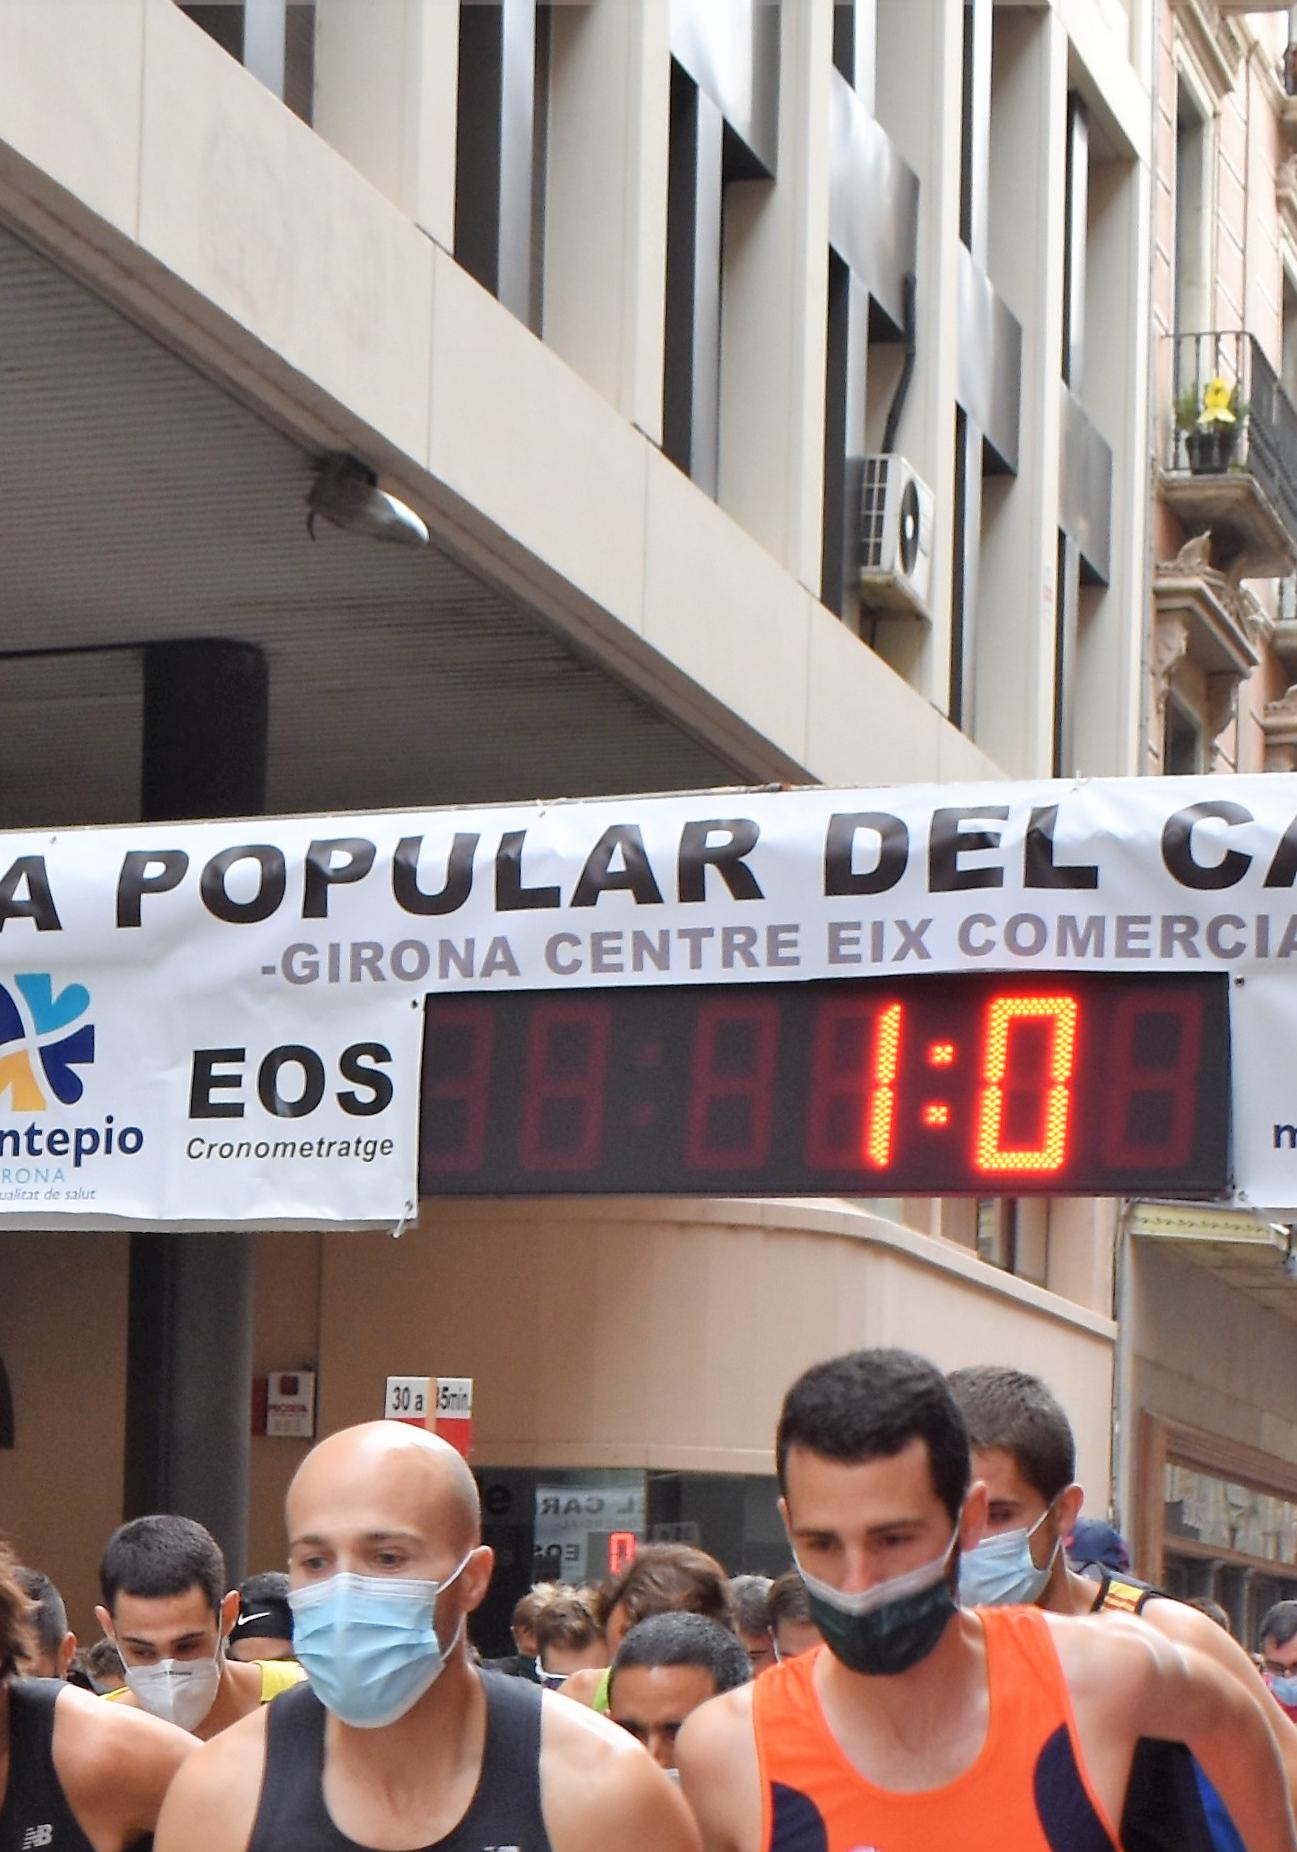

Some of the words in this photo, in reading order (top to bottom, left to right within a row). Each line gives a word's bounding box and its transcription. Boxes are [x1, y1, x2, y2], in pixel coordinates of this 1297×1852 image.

[116, 817, 766, 928] POPULAR
[824, 804, 1099, 896] DEL
[545, 923, 801, 975] CENTRE
[827, 917, 933, 966] EIX
[188, 1042, 394, 1119] EOS
[186, 1137, 394, 1162] Cronometratge
[44, 1187, 61, 1200] de
[65, 1186, 96, 1200] salut
[392, 1386, 411, 1411] 30
[415, 1393, 423, 1411] a
